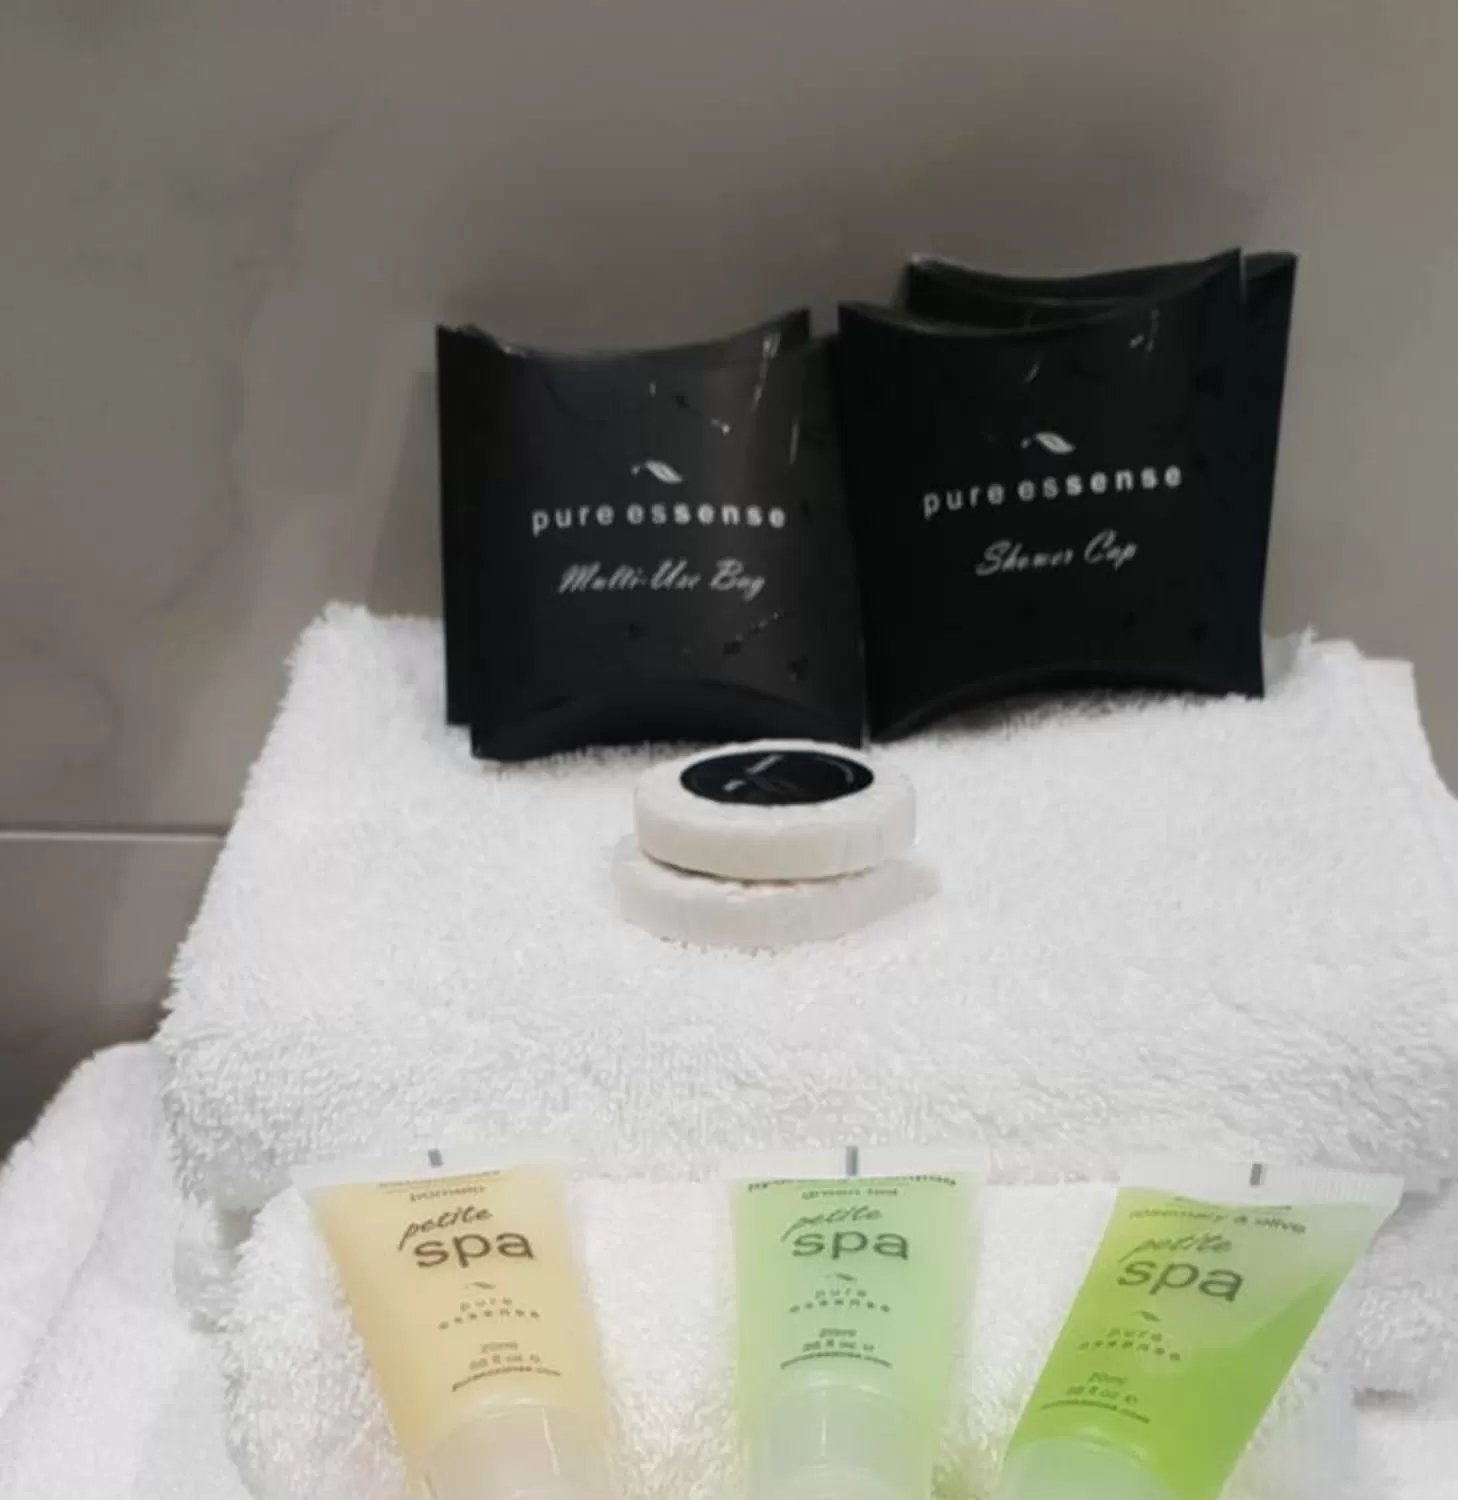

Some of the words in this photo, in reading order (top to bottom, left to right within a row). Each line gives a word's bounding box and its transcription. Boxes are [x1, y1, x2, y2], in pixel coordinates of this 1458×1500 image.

[922, 482, 1005, 520] pure
[1017, 465, 1182, 500] essense
[532, 503, 615, 537] pure
[626, 502, 786, 529] essense
[975, 538, 1074, 577] Shower
[1084, 528, 1138, 571] Cap
[557, 558, 701, 594] Multi-Use
[709, 556, 766, 602] Bag
[398, 1204, 493, 1252] petite
[779, 1205, 882, 1243] petite
[413, 1231, 535, 1269] spa
[792, 1230, 909, 1260] spa
[1116, 1231, 1233, 1264] petite
[1116, 1260, 1244, 1304] spa
